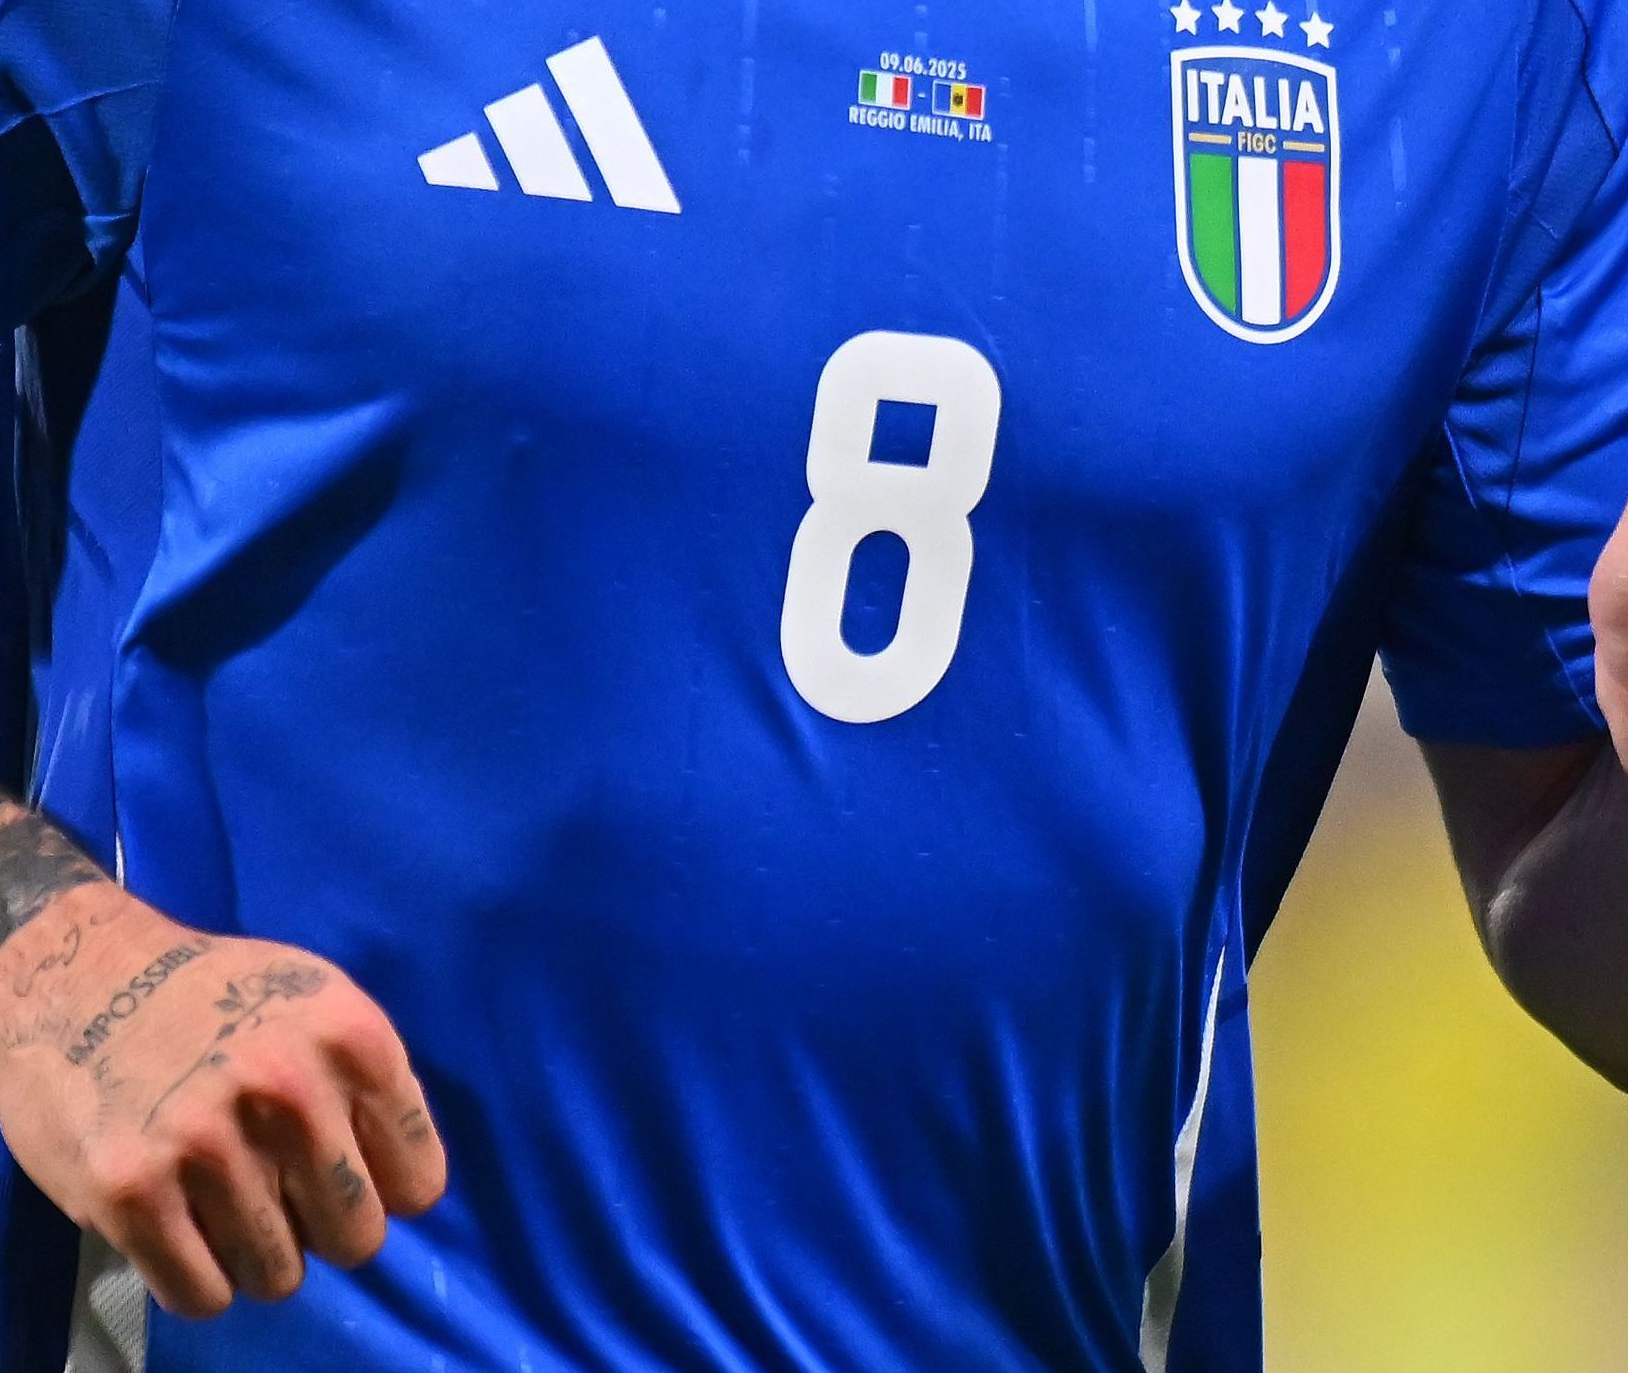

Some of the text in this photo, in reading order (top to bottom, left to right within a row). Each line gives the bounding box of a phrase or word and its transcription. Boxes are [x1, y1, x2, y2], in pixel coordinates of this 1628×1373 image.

[880, 52, 966, 79] 09.06.2025
[1187, 70, 1324, 133] ITALIA
[849, 107, 992, 143] REGGIO EMILIA, ITA
[1238, 131, 1277, 154] FIGC
[780, 329, 1001, 724] 8
